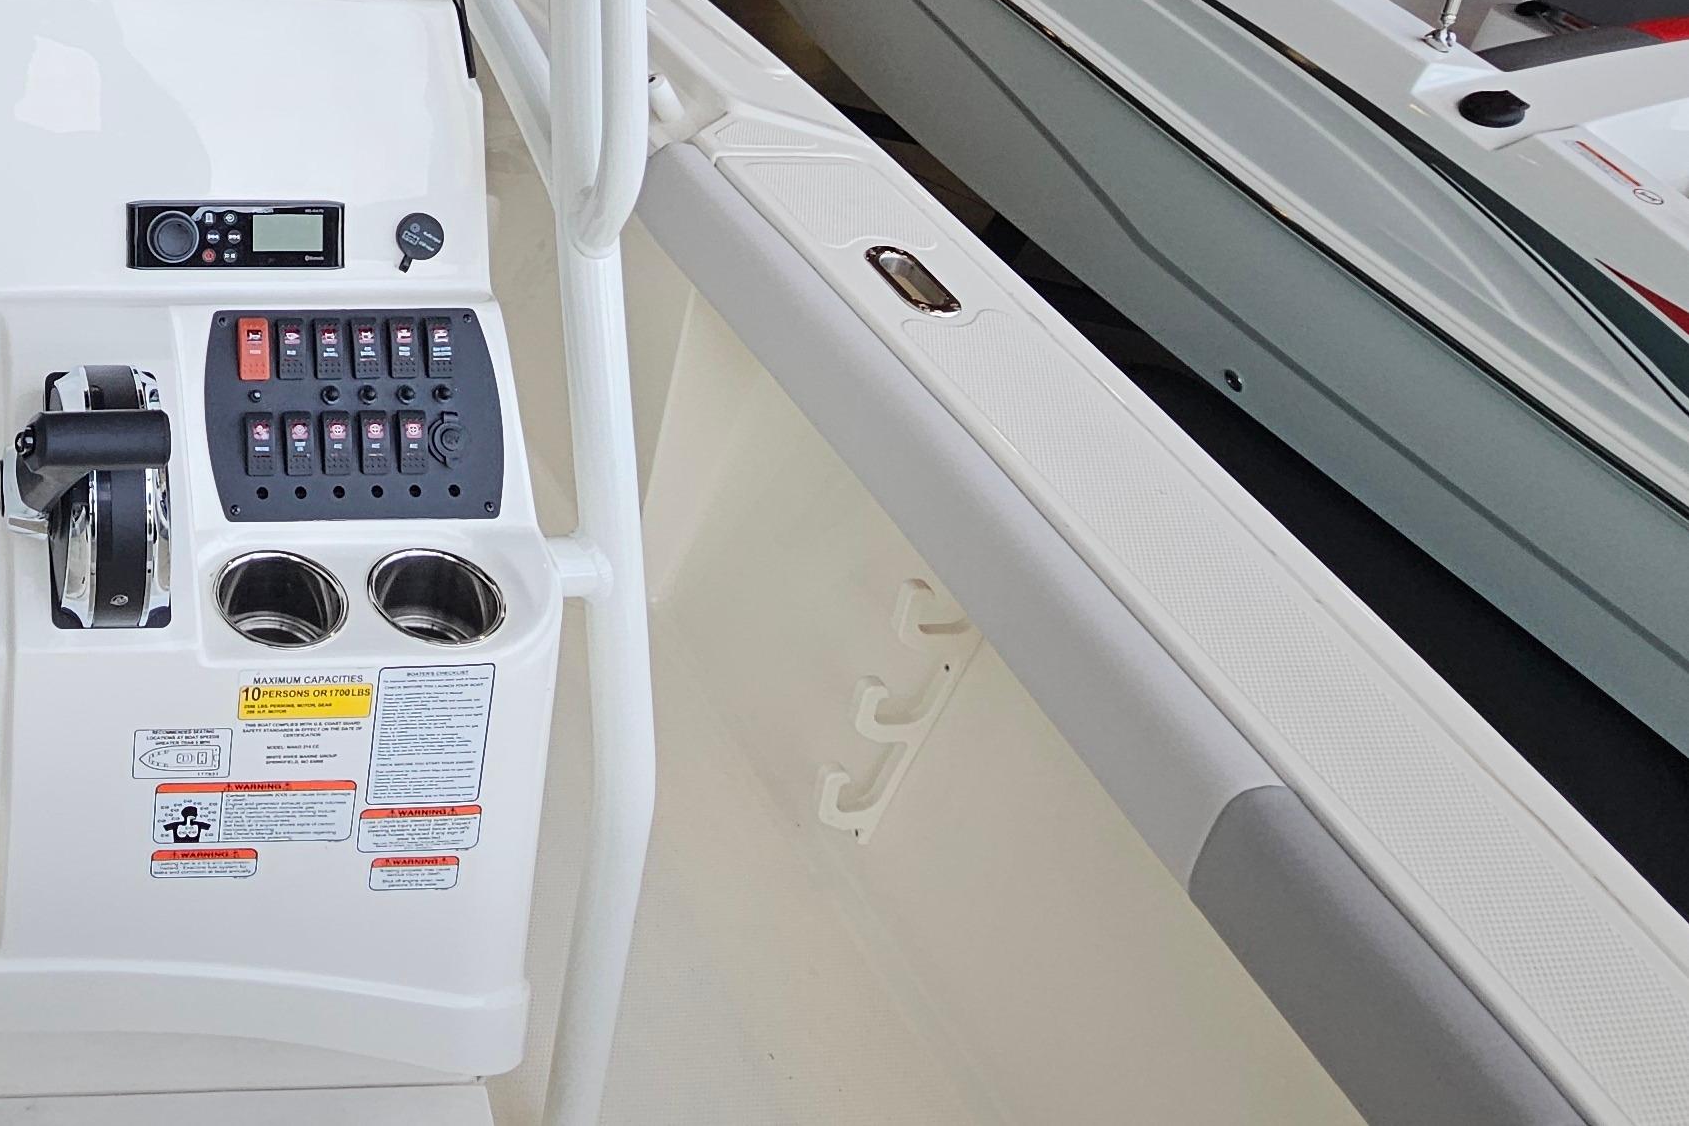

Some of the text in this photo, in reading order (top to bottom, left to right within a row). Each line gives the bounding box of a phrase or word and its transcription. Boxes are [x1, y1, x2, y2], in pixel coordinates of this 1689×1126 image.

[253, 675, 363, 685] MAXIMUM CAPACITIES
[242, 686, 372, 702] 10 PERSONS OR 1700 LBS
[234, 783, 282, 791] WARNING
[397, 809, 447, 817] WARNING
[180, 851, 229, 859] WARNING
